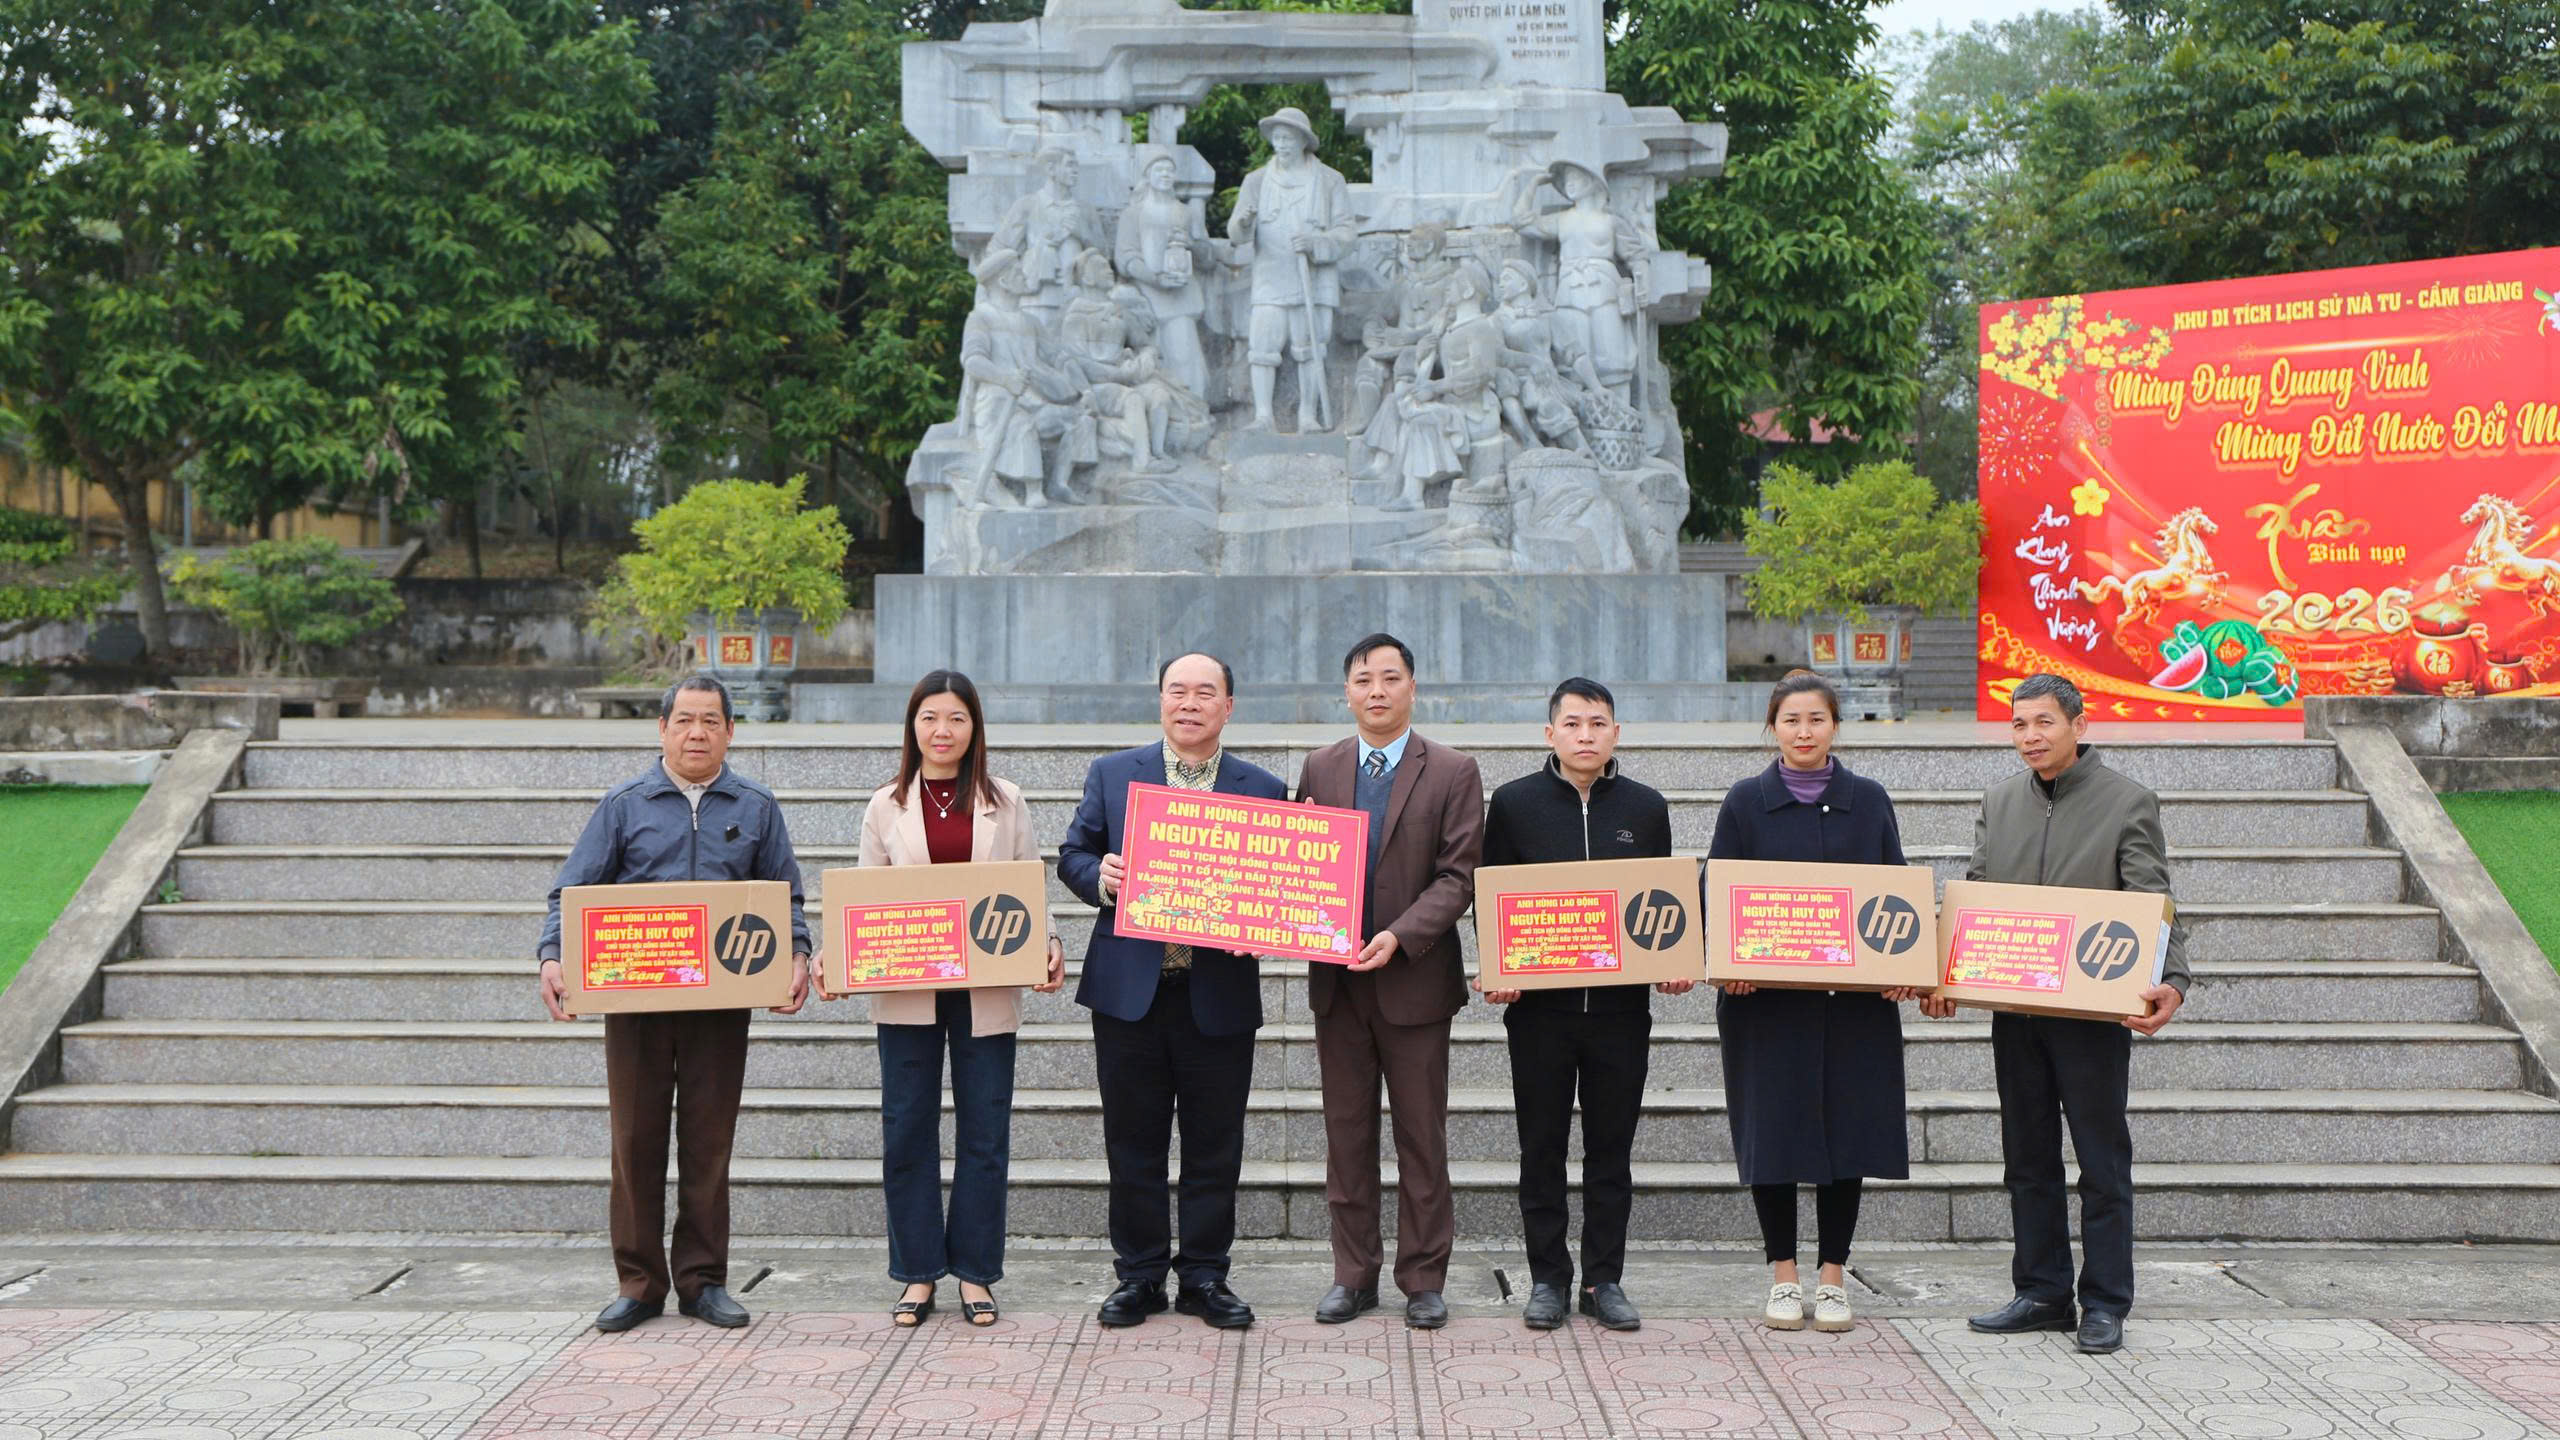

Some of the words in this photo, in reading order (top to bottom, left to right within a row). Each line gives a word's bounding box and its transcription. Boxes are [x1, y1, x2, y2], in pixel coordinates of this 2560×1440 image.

[2173, 310, 2208, 331] KHU
[2211, 308, 2229, 328] DI
[2233, 302, 2271, 325] TÍCH
[2275, 300, 2314, 324] LỊCH
[2319, 292, 2343, 318] SỬ
[2346, 291, 2373, 316] NÀ
[2377, 292, 2402, 312] TU
[2418, 280, 2460, 309] CẨM
[2464, 280, 2524, 305] GIÀNG
[2110, 370, 2185, 421] Mừng
[2191, 362, 2262, 416] Đảng
[2269, 357, 2353, 411] Quang
[2362, 348, 2430, 391] Vinh
[2215, 421, 2302, 475] Mừng
[2308, 413, 2365, 458] Đất
[2373, 411, 2446, 454] Nước
[2451, 400, 2508, 449] Đổi
[2031, 504, 2071, 532] An
[2245, 483, 2373, 591] Xuân
[2370, 544, 2407, 566] ngọ
[2030, 572, 2079, 611] Thịnh
[2256, 586, 2415, 634] 2026
[1857, 634, 1884, 659] 福
[2047, 607, 2103, 652] Vượng
[1166, 801, 1201, 818] ANH
[1204, 804, 1249, 824] HÙNG
[1252, 811, 1282, 829] LAO
[1285, 815, 1329, 835] ĐỘNG
[1149, 821, 1241, 851] NGUYỄN
[1247, 833, 1292, 857] HUY
[1297, 840, 1342, 864] QUÝ
[1148, 859, 1178, 872] CÔNG
[1181, 864, 1194, 873] TY
[1196, 864, 1212, 875] CỔ
[1213, 867, 1243, 880] PHẦN
[1245, 870, 1267, 883] ĐẦU
[1285, 876, 1306, 888] XÂY
[1308, 880, 1338, 893] DỰNG
[1168, 848, 1191, 859] CHỦ
[1193, 851, 1217, 863] TỊCH
[1219, 854, 1238, 867] HỘI
[1239, 856, 1269, 869] ĐỒNG
[1271, 861, 1301, 874] QUẢN
[1303, 865, 1321, 878] TRỊ
[864, 912, 881, 921] ANH
[883, 910, 906, 920] HÙNG
[907, 909, 923, 919] LAO
[924, 907, 947, 918] ĐỘNG
[1211, 898, 1233, 914] 32
[1237, 900, 1276, 919] MÁY
[1279, 904, 1320, 925] TÍNH
[1517, 899, 1534, 908] ANH
[1535, 898, 1558, 908] HÙNG
[1559, 898, 1575, 907] LAO
[1576, 896, 1600, 907] ĐỘNG
[1742, 903, 1789, 918] NGUYỄN
[1791, 907, 1815, 919] HUY
[1818, 906, 1841, 920] QUÝ
[1749, 892, 1767, 901] ANH
[1768, 892, 1792, 902] HÙNG
[1793, 893, 1809, 902] LAO
[1810, 892, 1834, 903] ĐỘNG
[595, 924, 643, 941] NGUYỄN
[645, 926, 669, 940] HUY
[671, 924, 696, 939] QUÝ
[603, 914, 621, 923] ANH
[622, 912, 646, 923] HÙNG
[647, 912, 663, 922] LAO
[664, 911, 688, 923] ĐỘNG
[856, 921, 904, 938] NGUYỄN
[906, 923, 929, 936] HUY
[931, 919, 954, 934] QUÝ
[976, 894, 1026, 955] hp
[1144, 912, 1172, 933] TRỊ
[1176, 916, 1205, 934] GIÁ
[1209, 920, 1241, 939] 500
[1245, 924, 1294, 947] TRIỆU
[1297, 932, 1332, 951] VNĐ
[1509, 909, 1556, 926] NGUYỄN
[1558, 912, 1581, 925] HUY
[1584, 908, 1607, 924] QUÝ
[1632, 889, 1681, 951] hp
[1864, 895, 1915, 955] hp
[721, 914, 771, 975] hp
[1965, 927, 2010, 943] NGUYỄN
[2011, 932, 2035, 944] HUY
[2037, 932, 2061, 946] QUÝ
[2081, 920, 2135, 981] hp
